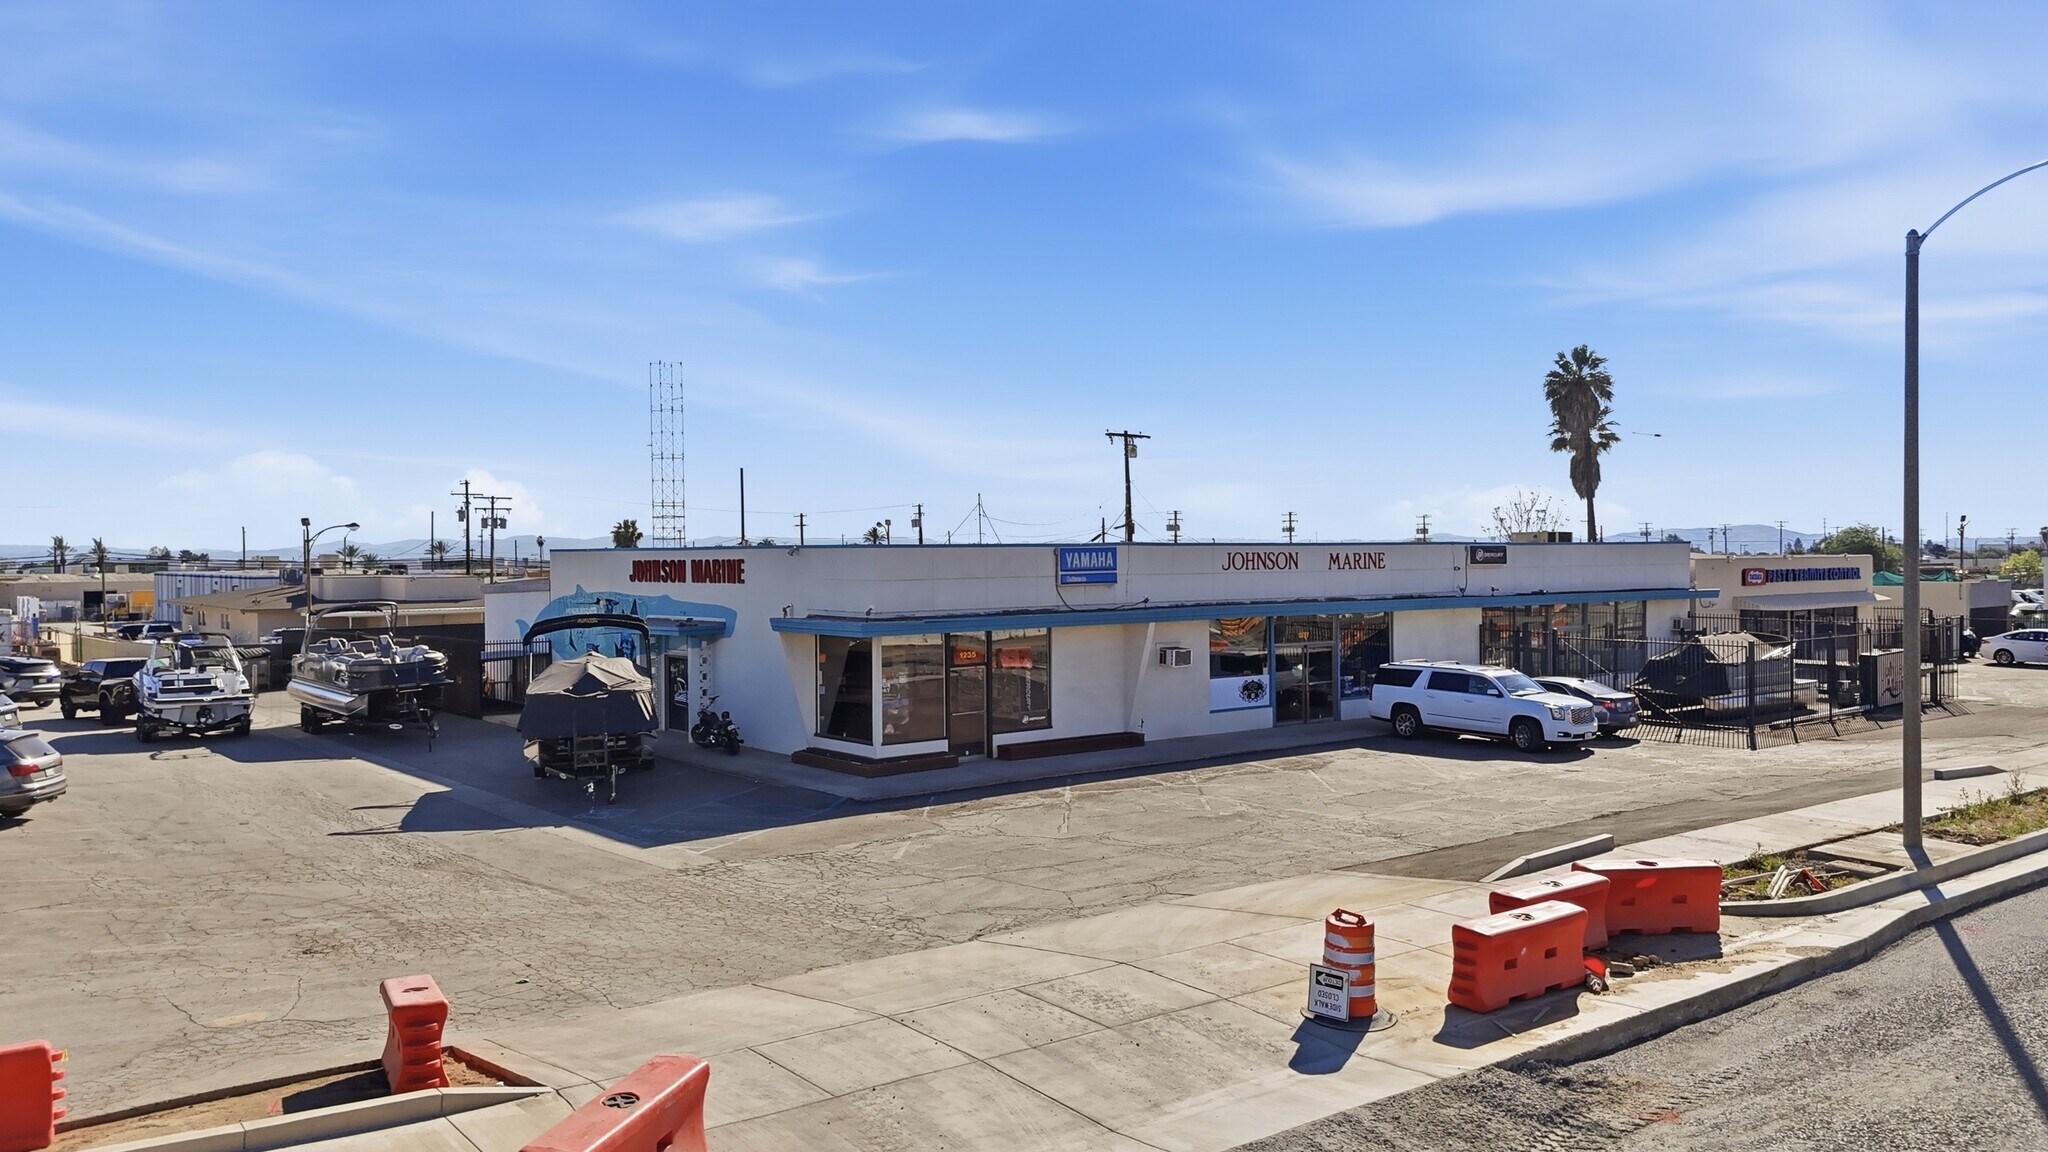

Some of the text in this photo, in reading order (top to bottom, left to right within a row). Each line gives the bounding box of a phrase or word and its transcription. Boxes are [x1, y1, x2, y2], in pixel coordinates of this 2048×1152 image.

[1065, 552, 1113, 568] YAMAHA
[1222, 552, 1386, 570] JOHNSON MARINE
[629, 559, 745, 584] JOHNSON MARINE
[1795, 568, 1829, 582] TERMITE
[1322, 976, 1341, 986] DETOUR
[1318, 989, 1340, 1002] CLOSED
[1314, 999, 1342, 1012] SIDEWALK
